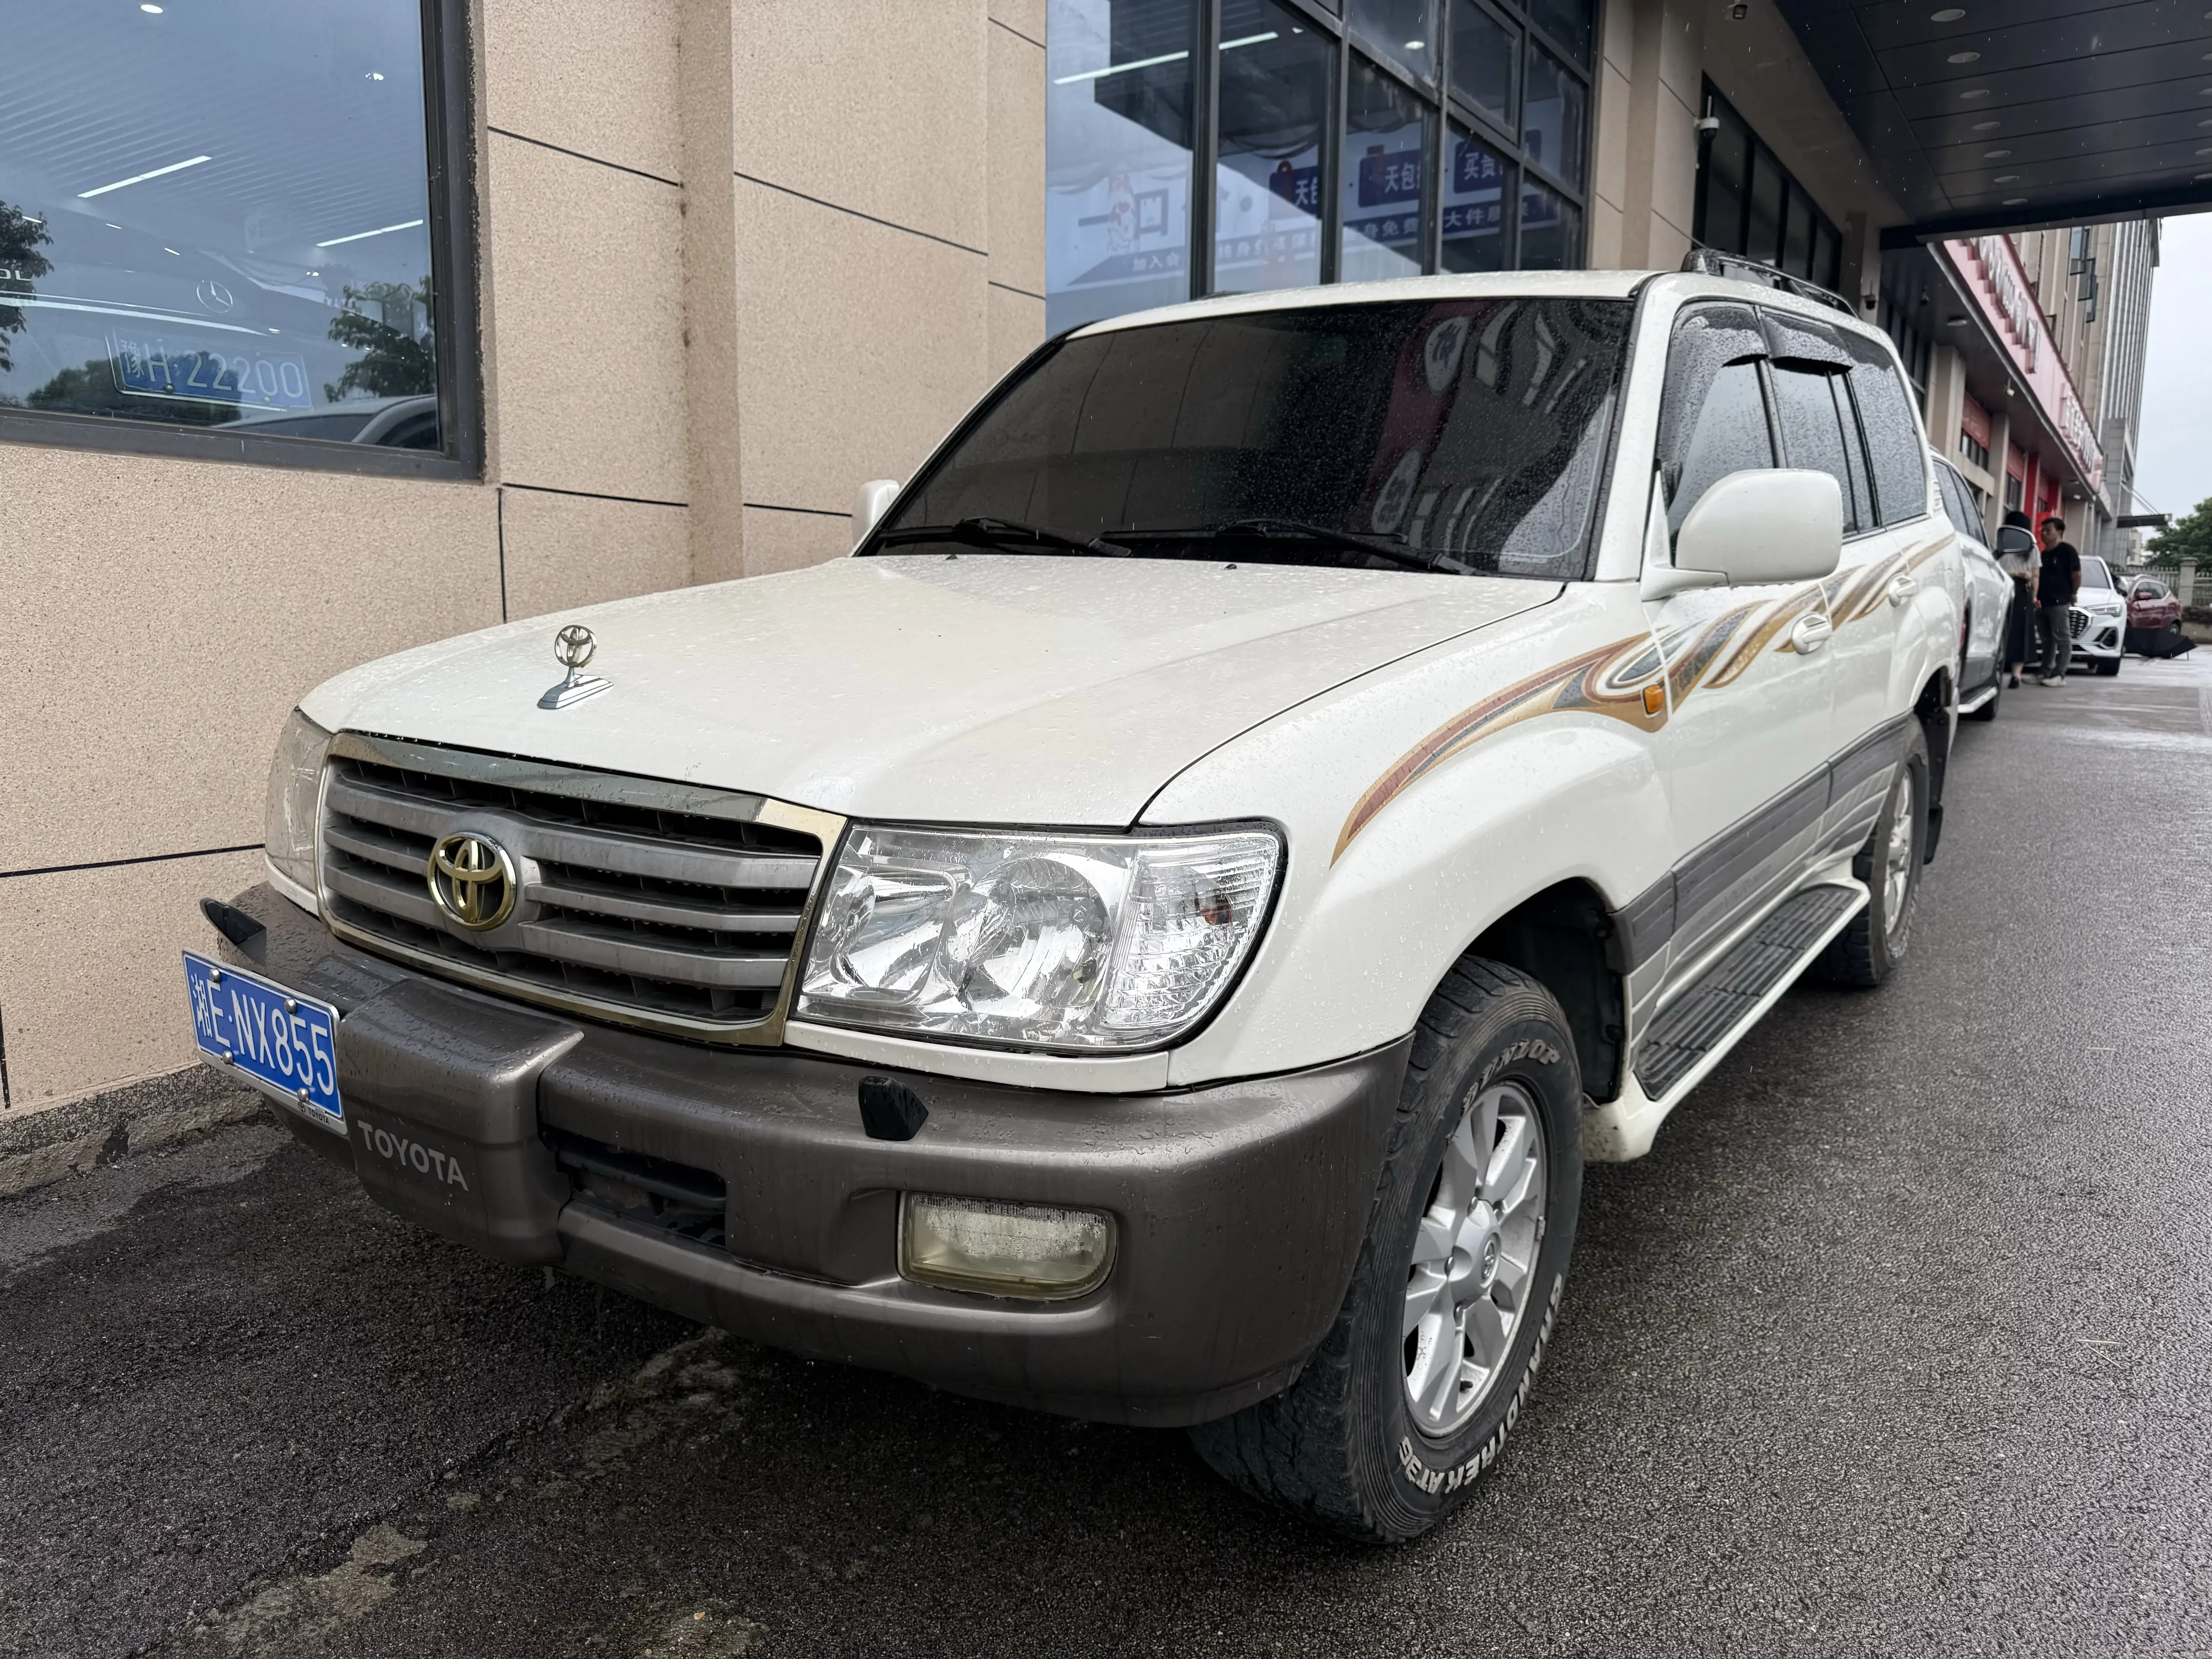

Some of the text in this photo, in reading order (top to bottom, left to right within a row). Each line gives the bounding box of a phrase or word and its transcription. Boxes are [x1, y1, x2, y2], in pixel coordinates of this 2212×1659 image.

[1384, 161, 1421, 194] 天包
[1464, 151, 1503, 180] 买贵
[1479, 1038, 1561, 1090] DUNLOP
[308, 1107, 330, 1125] TOYOTA
[357, 1120, 469, 1192] TOYOTA
[1444, 1273, 1563, 1494] GRANDTREK
